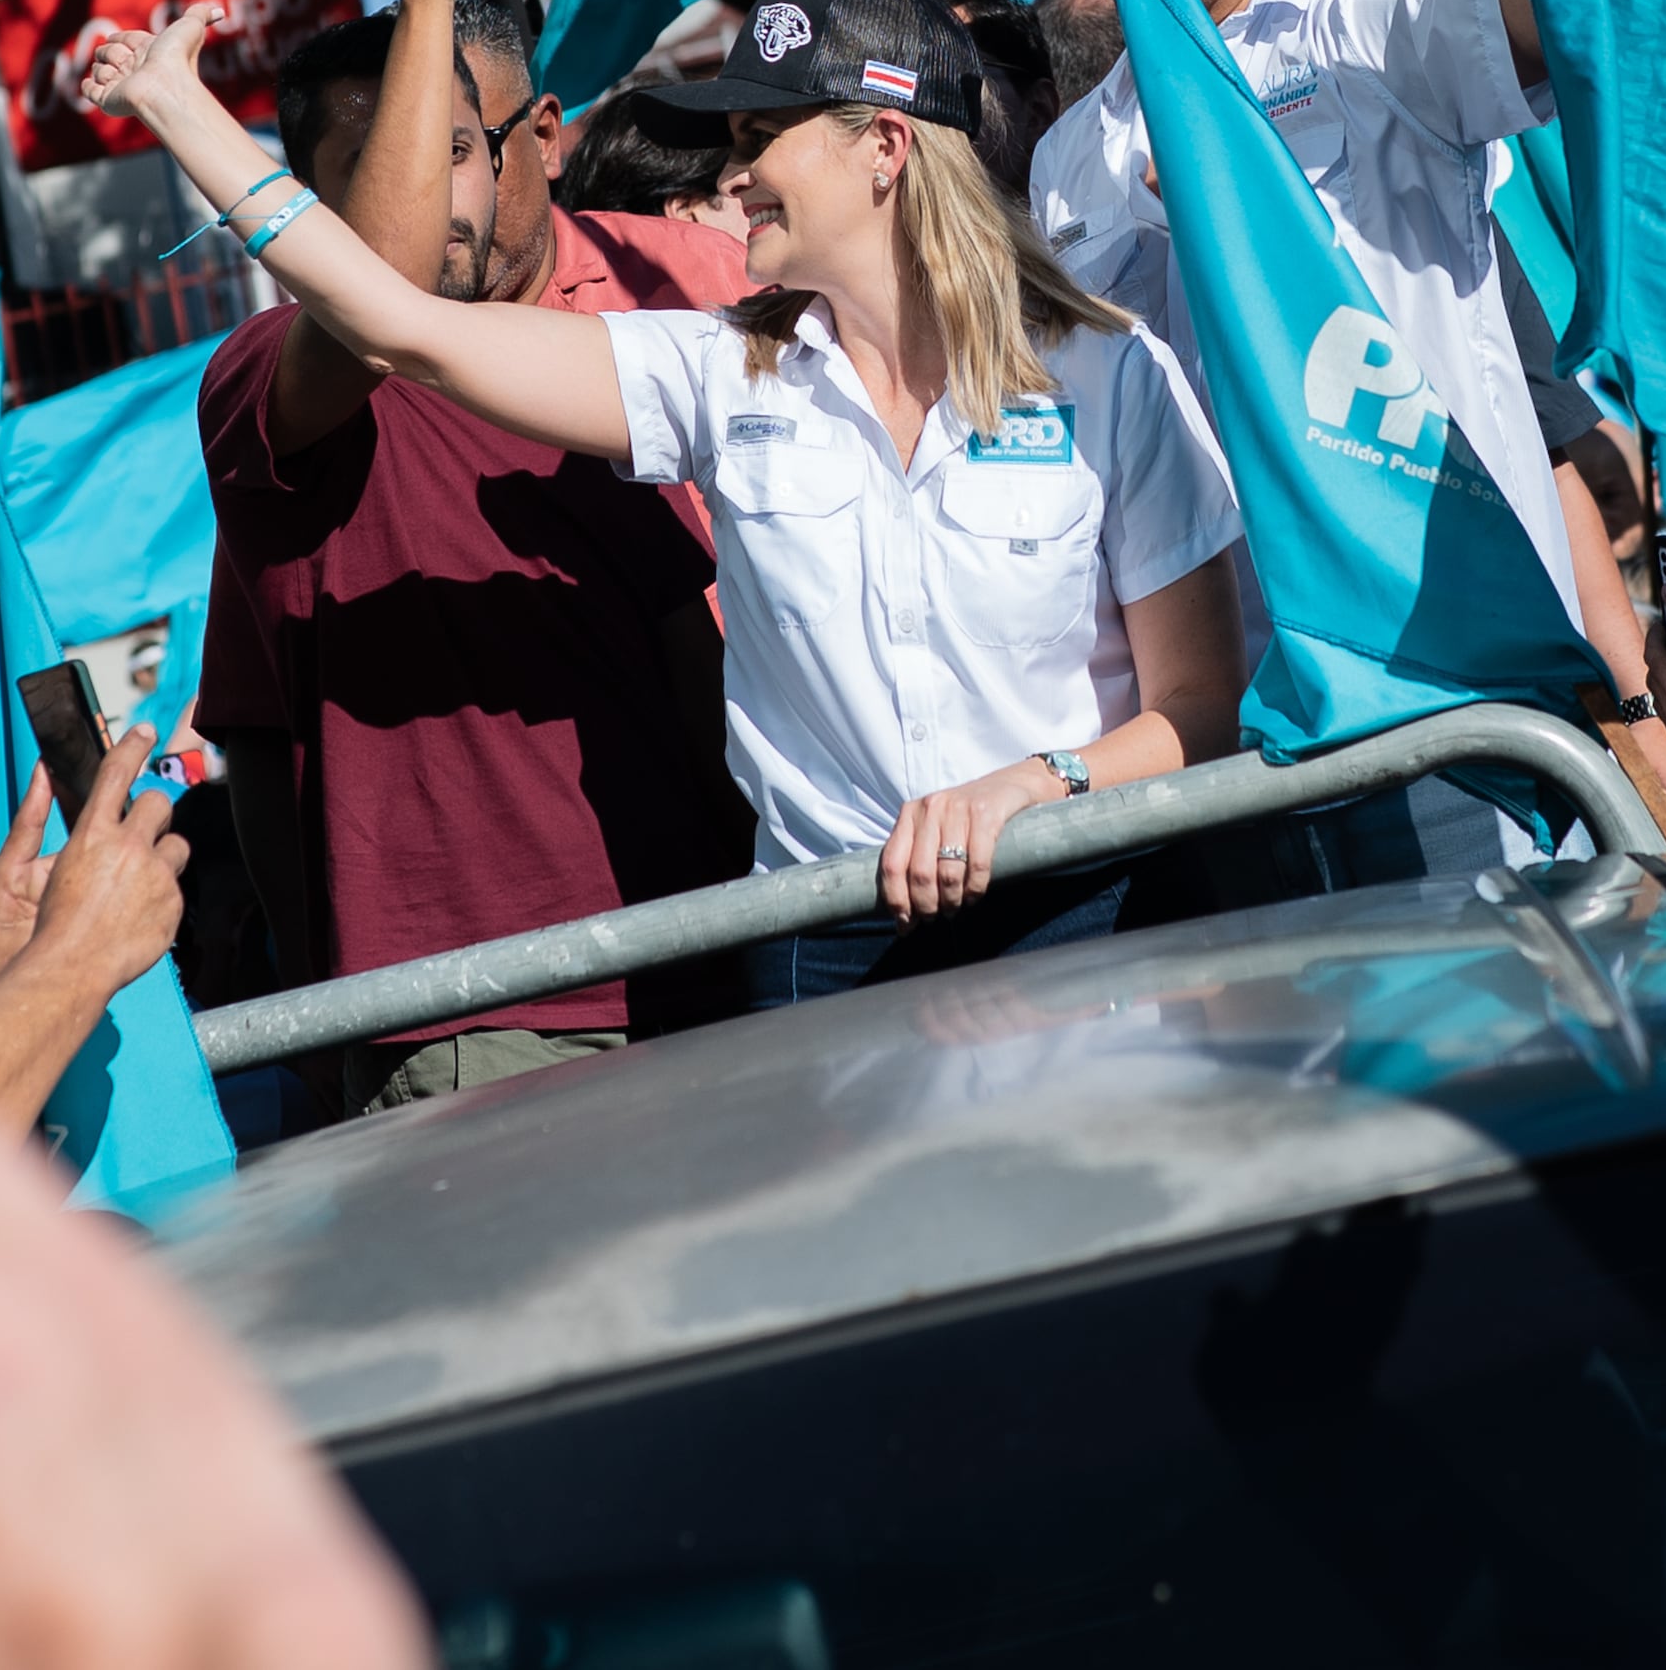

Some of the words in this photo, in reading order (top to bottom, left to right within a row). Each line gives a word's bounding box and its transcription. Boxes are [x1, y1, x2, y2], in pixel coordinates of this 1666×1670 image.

[1256, 60, 1318, 96] AURA
[1267, 96, 1313, 119] SIDENTE
[1306, 425, 1385, 466] Partido
[1388, 452, 1463, 491] Pueblo
